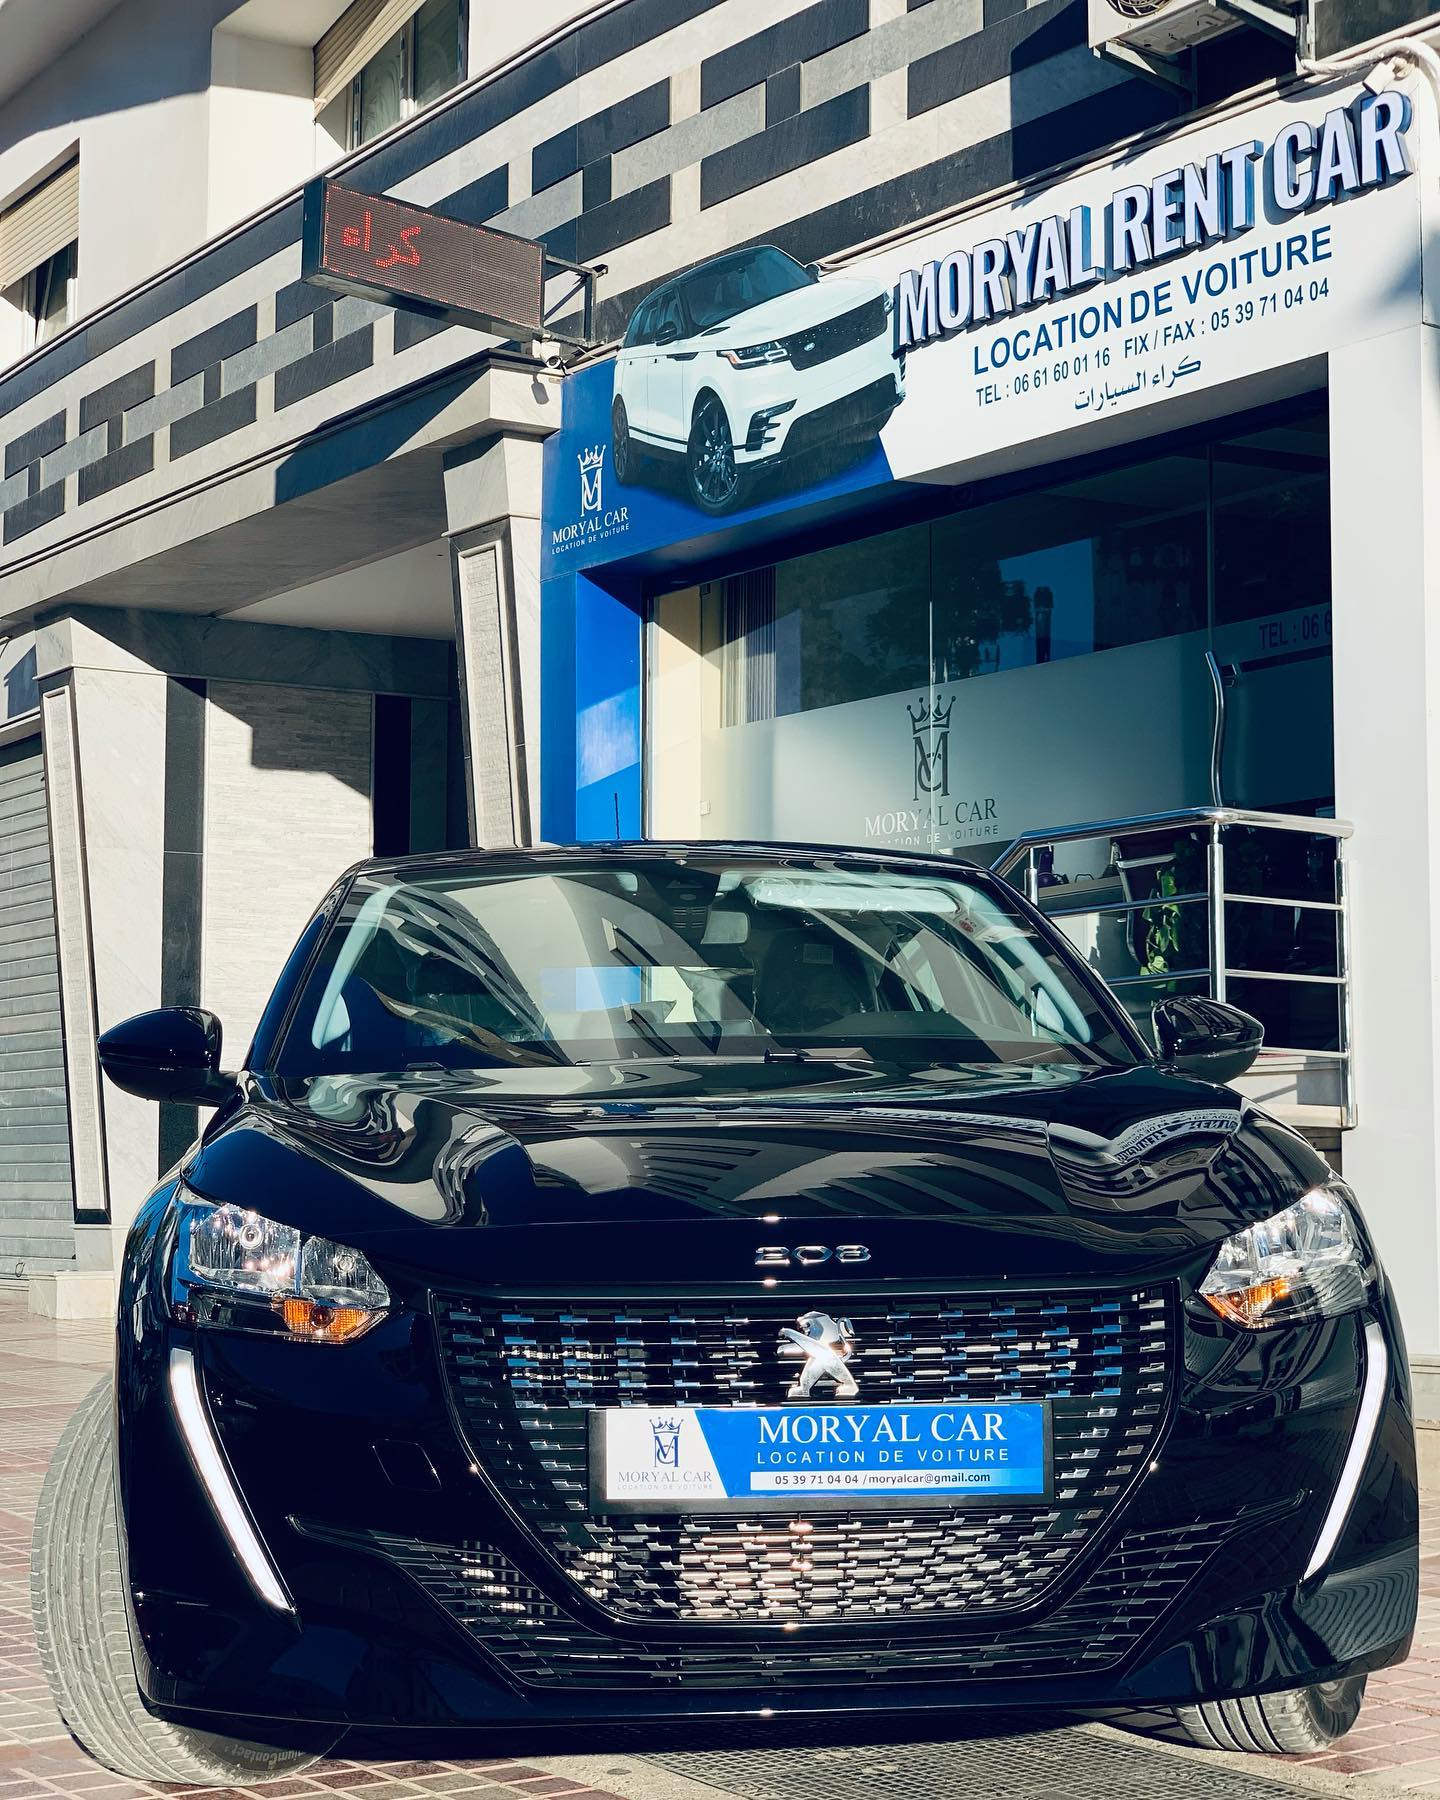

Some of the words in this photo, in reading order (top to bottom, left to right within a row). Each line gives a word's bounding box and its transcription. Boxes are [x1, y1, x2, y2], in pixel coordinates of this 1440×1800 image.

[897, 206, 1103, 351] MORYAL
[1112, 140, 1264, 272] RENT
[1273, 91, 1414, 213] CAR
[974, 297, 1123, 376] LOCATION
[1130, 280, 1173, 324] DE
[1181, 224, 1333, 305] VOITURE
[976, 383, 1002, 407] TEL
[1014, 373, 1029, 395] 06
[1033, 367, 1048, 389] 61
[1053, 361, 1069, 382] 60
[1073, 354, 1088, 376] 01
[1094, 347, 1110, 369] 16
[1124, 333, 1149, 359] FIX
[1163, 319, 1196, 347] FAX
[1211, 308, 1230, 331] 05
[1235, 301, 1254, 325] 39
[1259, 293, 1277, 316] 71
[1284, 285, 1304, 309] 04
[1309, 277, 1330, 302] 04
[1152, 356, 1202, 388] كراء
[1074, 369, 1147, 412] السيارات
[551, 540, 586, 555] LOCATION
[588, 534, 597, 544] DE
[600, 523, 630, 538] VOITURE
[552, 516, 602, 546] MORYAL
[604, 506, 629, 527] CAR
[1259, 620, 1289, 650] TEL
[1302, 613, 1319, 641] 06
[864, 805, 949, 838] MORYAL
[954, 798, 998, 825] CAR
[926, 832, 941, 844] DE
[754, 1244, 872, 1266] 208
[756, 1414, 921, 1445] MORYAL
[930, 1412, 1008, 1442] CAR
[757, 1450, 865, 1465] LOCATION
[879, 1449, 904, 1463] DE
[917, 1448, 1009, 1463] VOITURE
[617, 1471, 679, 1482] MORYAL
[683, 1471, 712, 1482] CAR
[775, 1475, 789, 1486] 05
[792, 1475, 806, 1486] 39
[810, 1475, 823, 1485] 71
[827, 1474, 842, 1485] 04
[844, 1474, 859, 1485] 04
